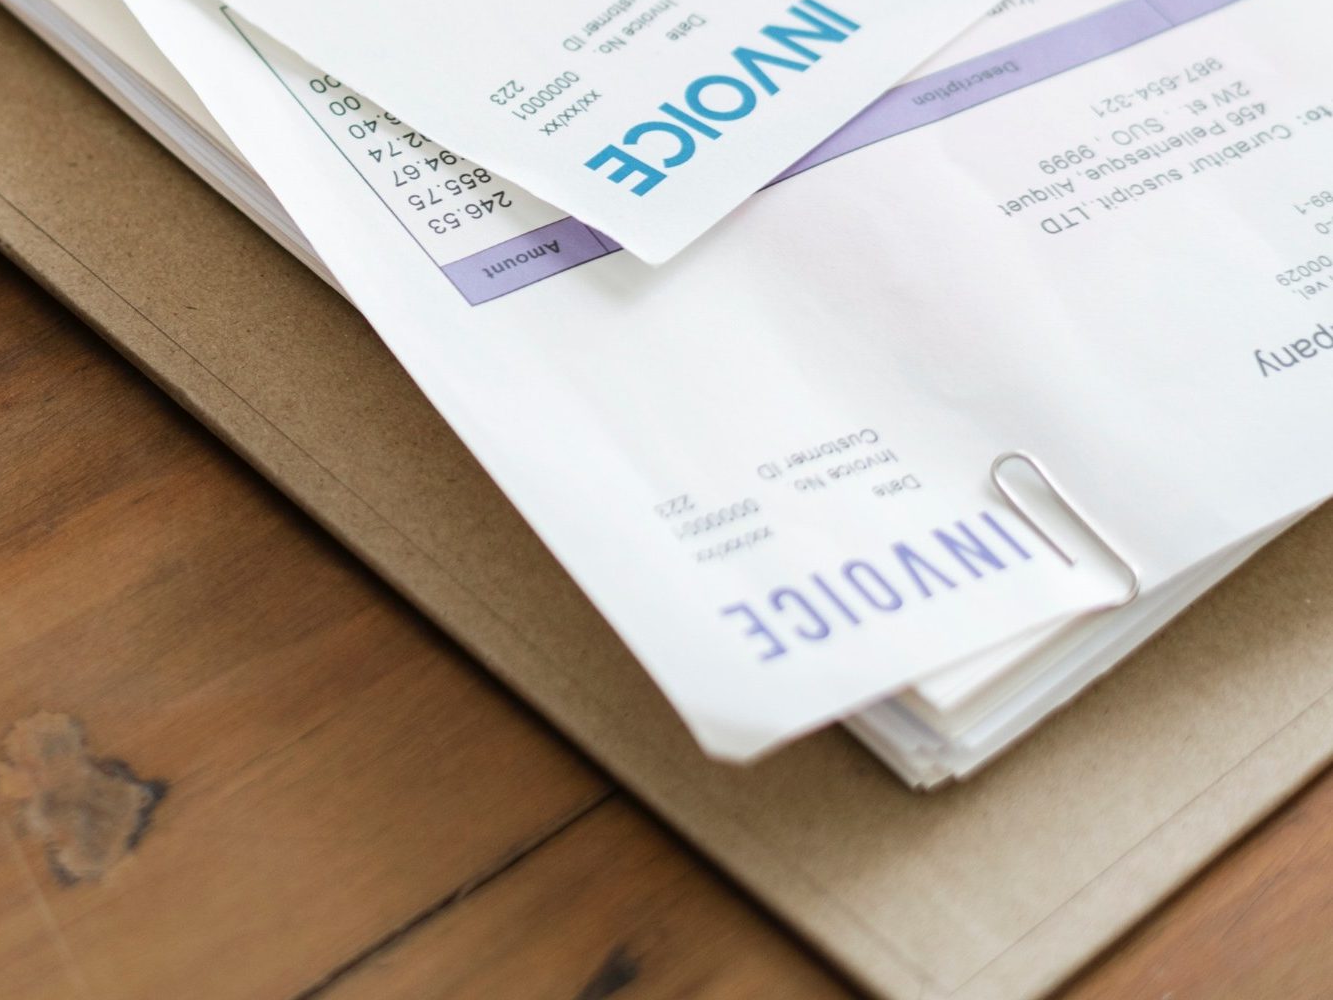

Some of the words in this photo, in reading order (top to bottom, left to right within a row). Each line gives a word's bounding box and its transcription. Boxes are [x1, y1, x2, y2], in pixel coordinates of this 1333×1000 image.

[561, 31, 584, 53] ID
[665, 11, 707, 43] Date
[488, 79, 525, 107] 223
[510, 70, 580, 122] 0000001
[911, 60, 1021, 109] Description
[1089, 56, 1224, 119] 987-654-321
[1211, 80, 1250, 106] 2W
[538, 89, 603, 136] xx/xx/xx
[1110, 117, 1165, 147] SUO
[1226, 101, 1267, 127] 456
[367, 131, 432, 164] 2.74
[1038, 143, 1096, 176] 9999
[1188, 122, 1293, 175] Curabitur
[391, 149, 465, 188] 94.67
[407, 167, 492, 212] 855.75
[997, 178, 1075, 218] Aliquet
[426, 190, 513, 235] 246.53
[481, 238, 562, 280] Amount
[1253, 323, 1333, 379] pany
[783, 427, 880, 469] Customer
[826, 448, 899, 481] Invoice
[755, 460, 784, 481] ID
[871, 473, 922, 500] Date
[717, 510, 1033, 664] INVOICE
